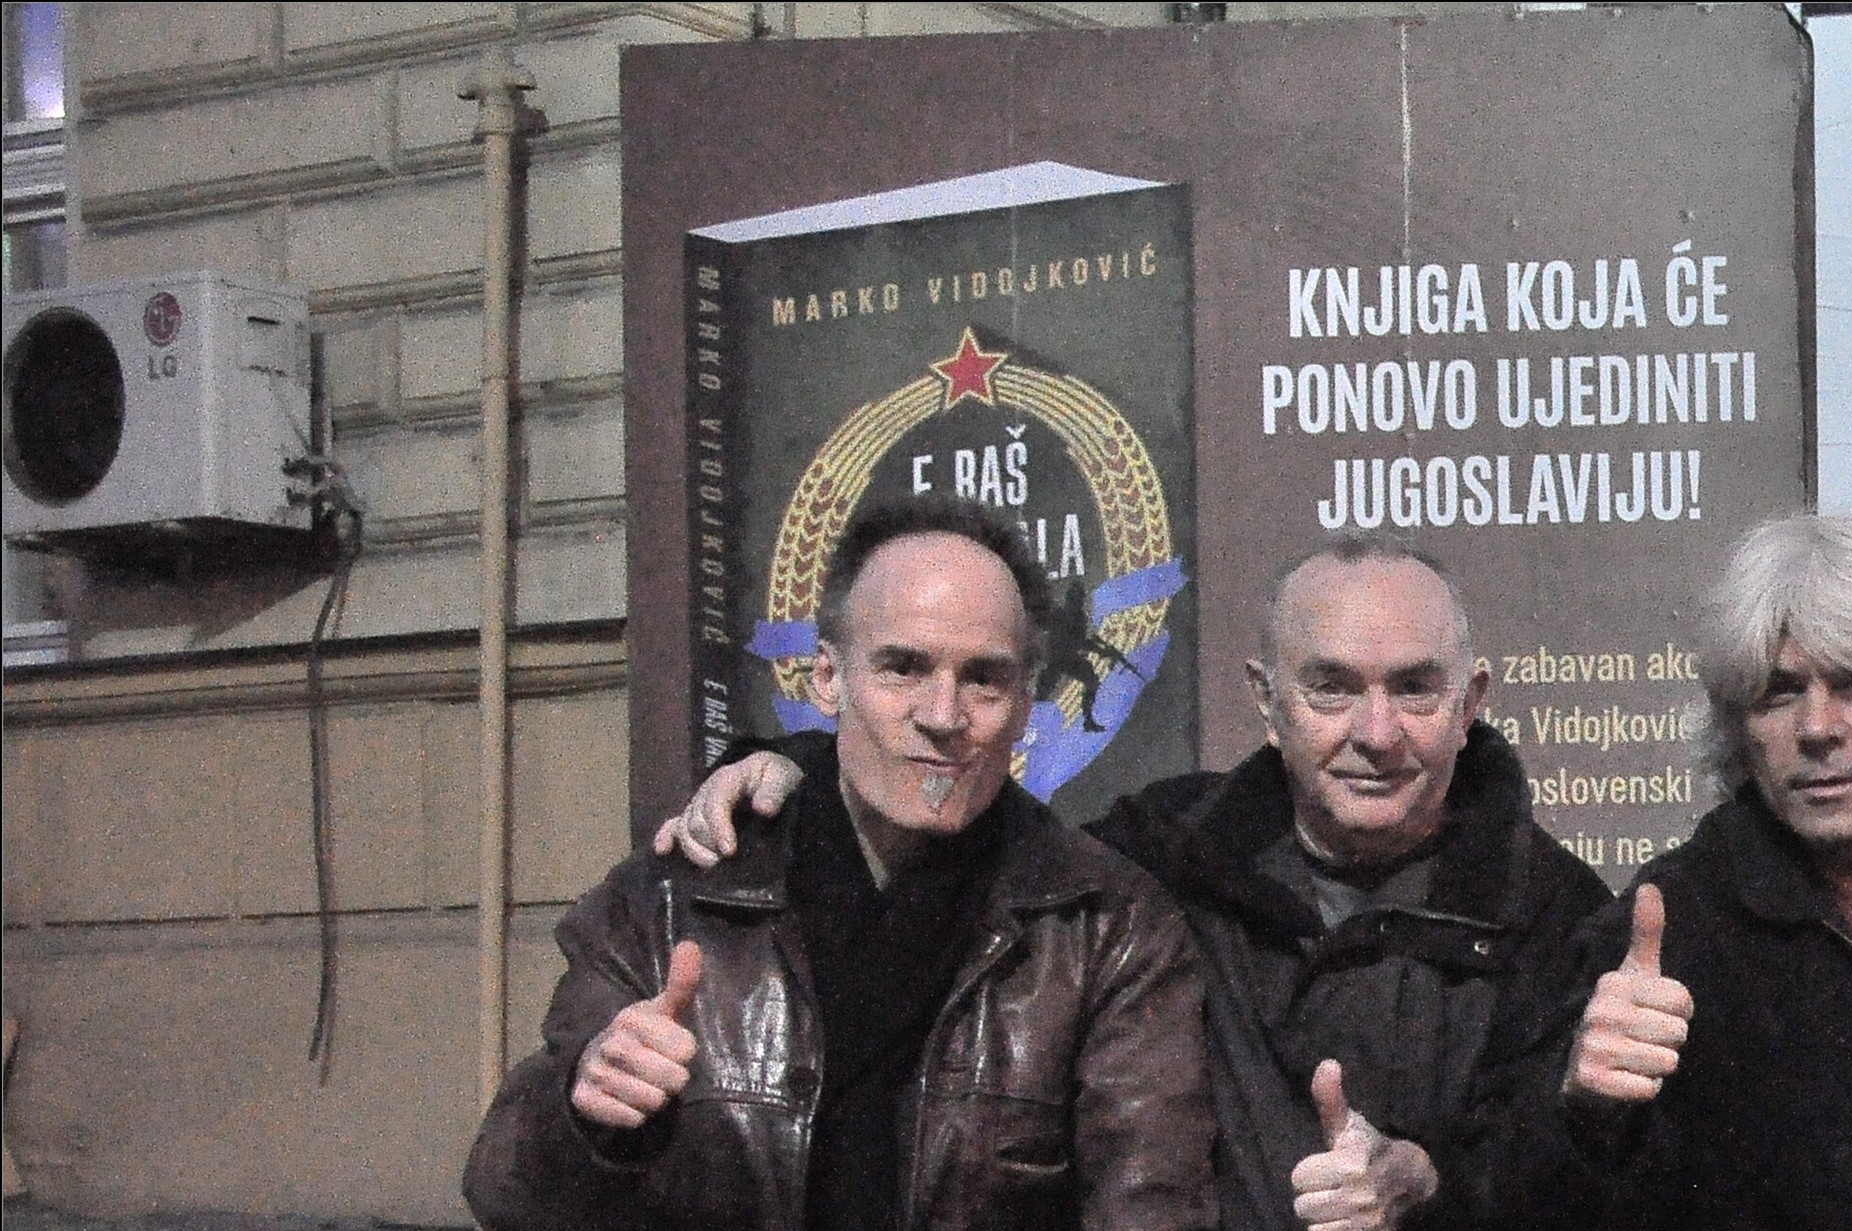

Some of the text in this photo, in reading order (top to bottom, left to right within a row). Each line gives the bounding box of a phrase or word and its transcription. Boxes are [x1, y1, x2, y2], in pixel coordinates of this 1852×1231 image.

[772, 242, 1157, 328] MARKO VIDOJKOVIĆ
[1288, 239, 1729, 338] KNJIGA KOJA ĆE
[147, 354, 178, 380] LG
[698, 265, 722, 392] MARKO
[1262, 350, 1758, 436] PONOVO UJEDINITI
[1317, 450, 1701, 530] JUGOSLAVIJU!
[1502, 646, 1635, 684] zabavan
[1527, 765, 1693, 806] slovenski
